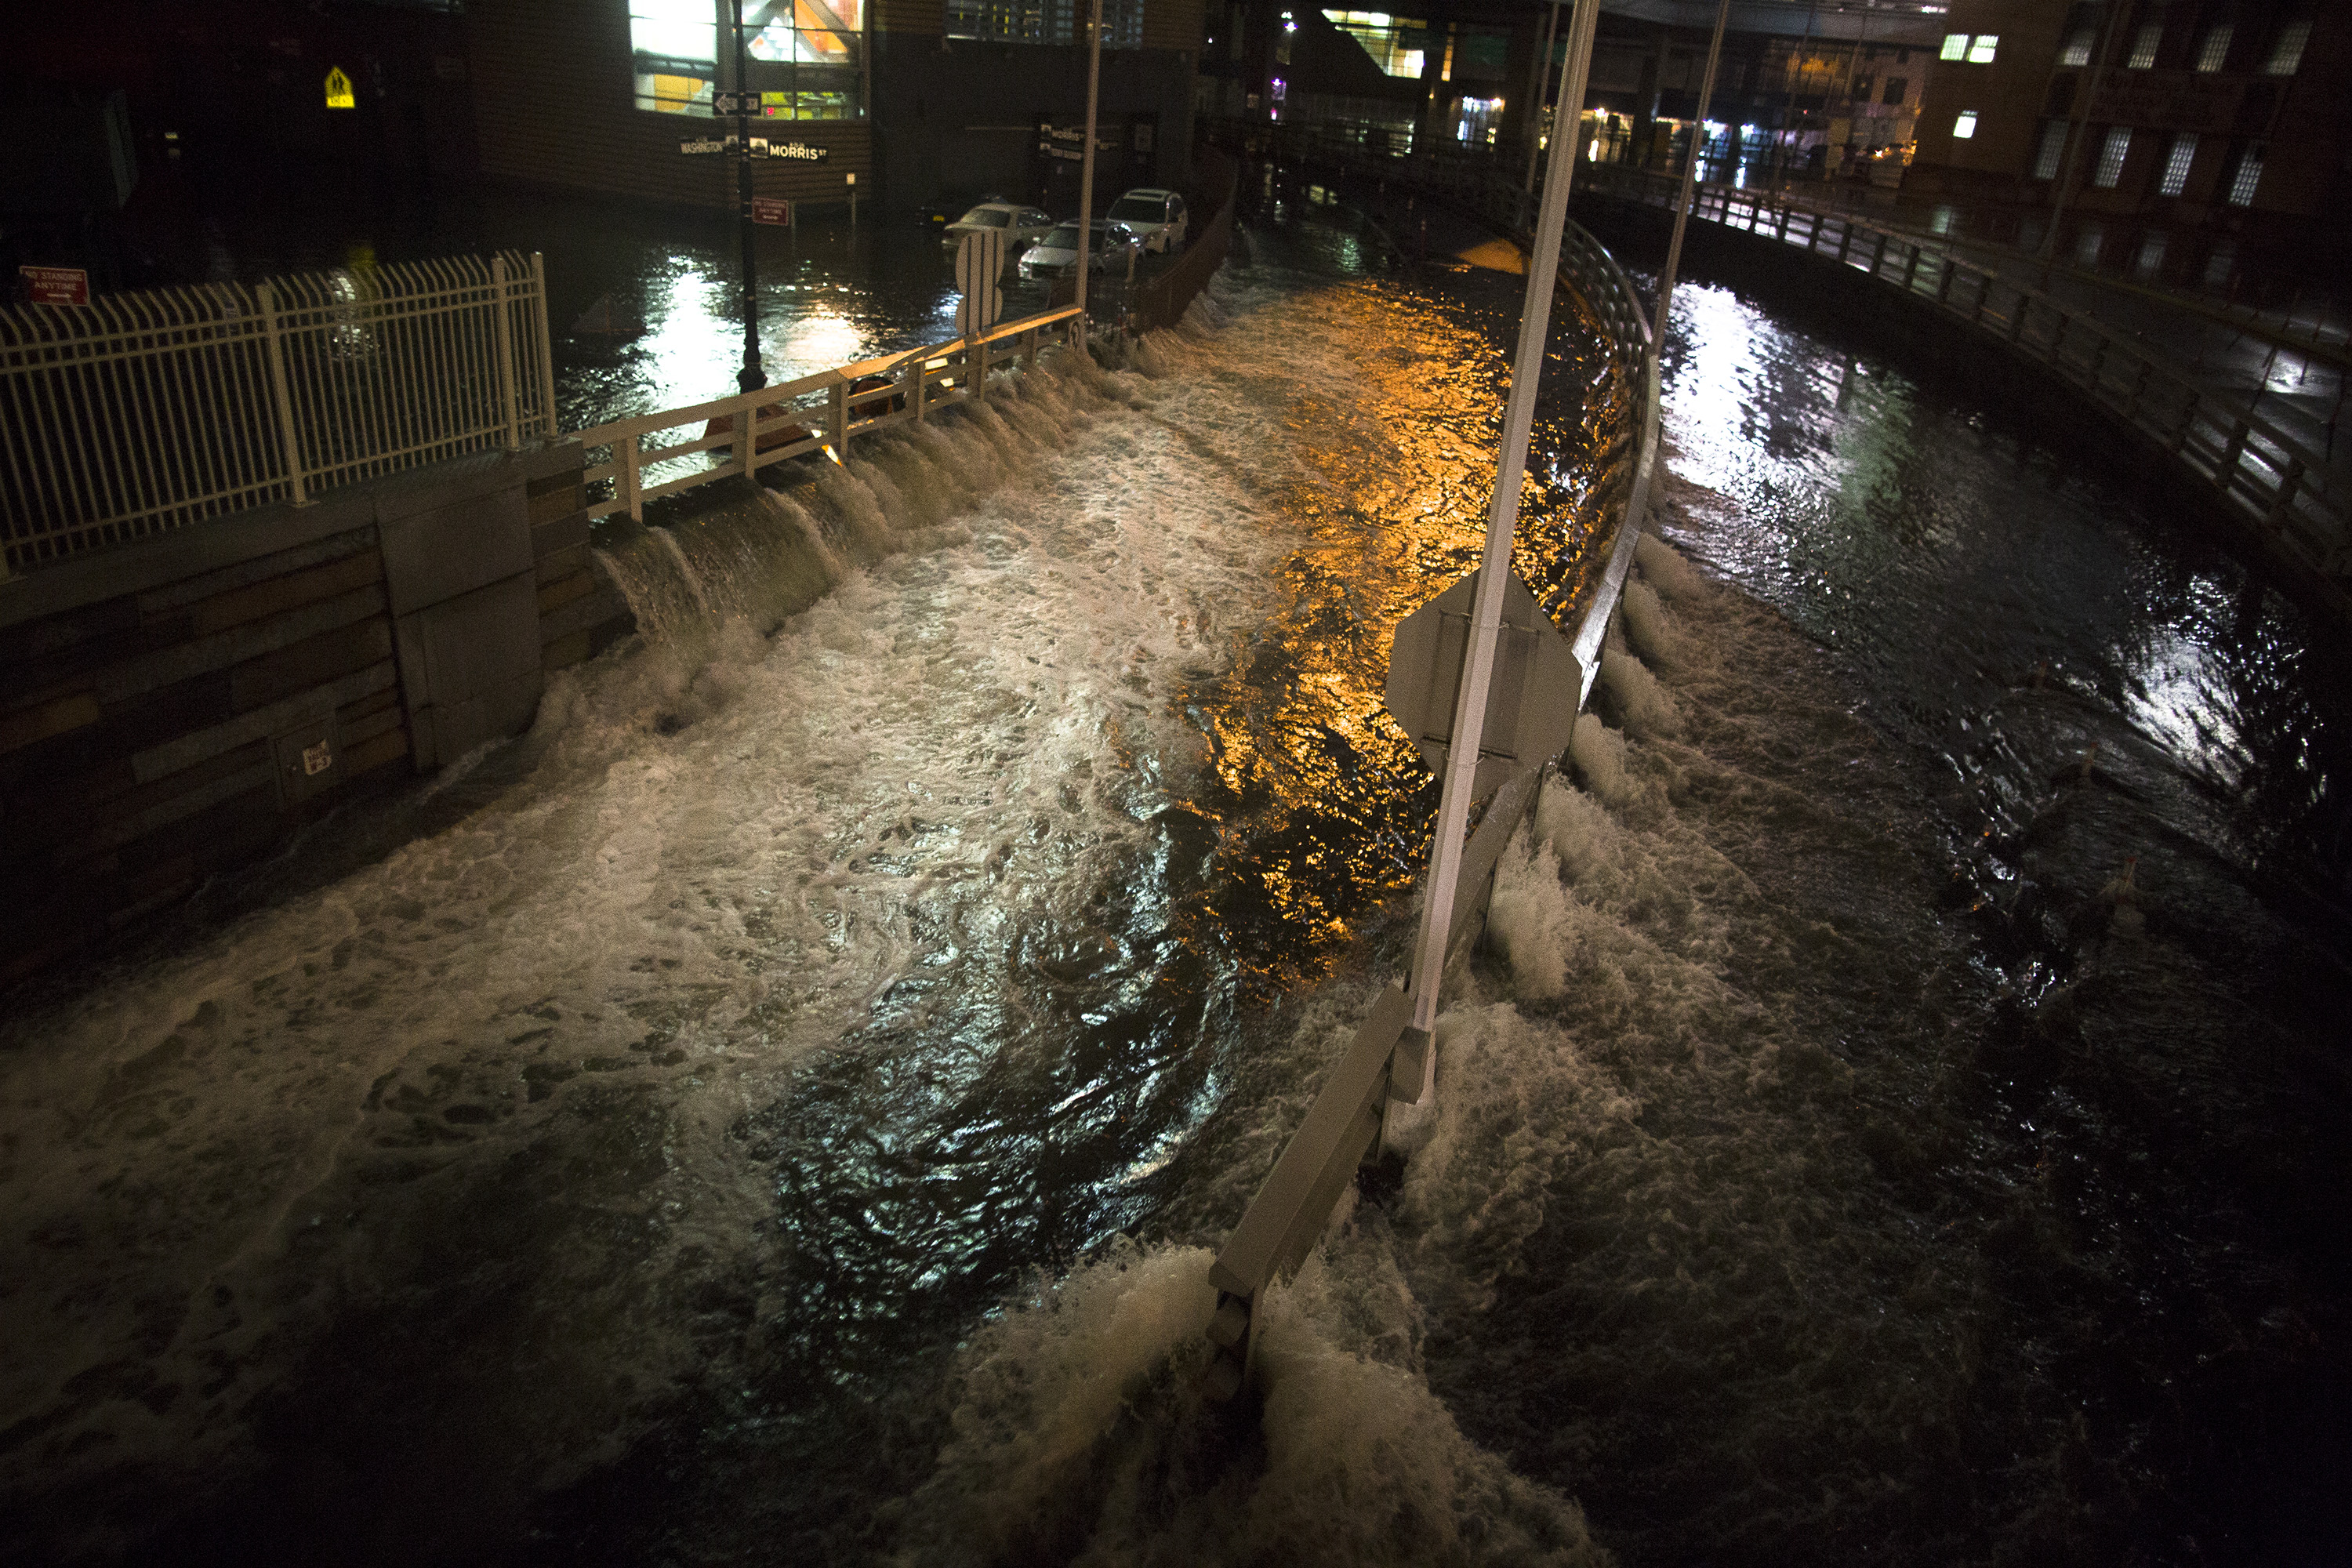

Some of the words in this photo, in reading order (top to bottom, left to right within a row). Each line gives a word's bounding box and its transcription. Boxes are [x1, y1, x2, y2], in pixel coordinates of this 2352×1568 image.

[770, 144, 818, 161] MORRIS
[41, 271, 83, 282] STANDING
[34, 281, 78, 291] ANYTIME
